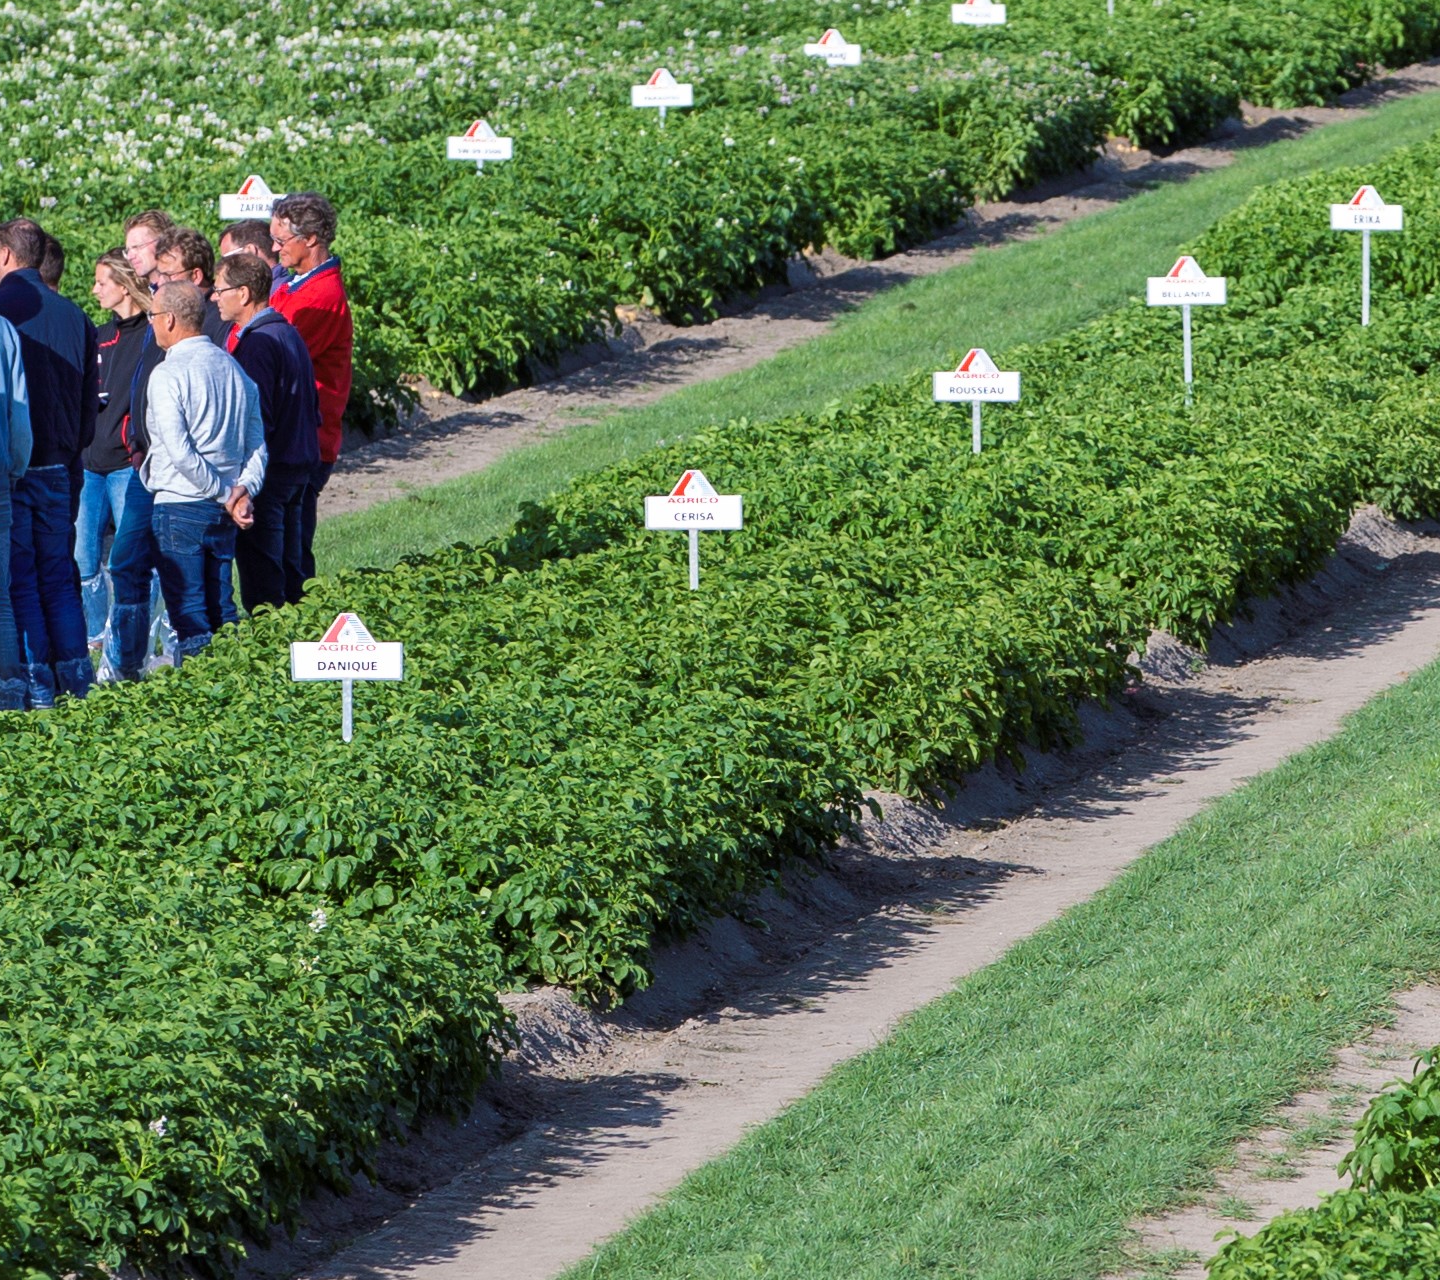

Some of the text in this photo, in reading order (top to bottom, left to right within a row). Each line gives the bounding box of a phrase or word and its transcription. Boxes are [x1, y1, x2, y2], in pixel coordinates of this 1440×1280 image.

[240, 203, 271, 212] ZAFIRA
[1353, 214, 1381, 225] ERIKA
[948, 386, 1005, 395] ROUSSEAU
[673, 512, 715, 521] CERISA
[318, 643, 377, 652] AGRICO
[317, 661, 378, 673] DANIQUE
